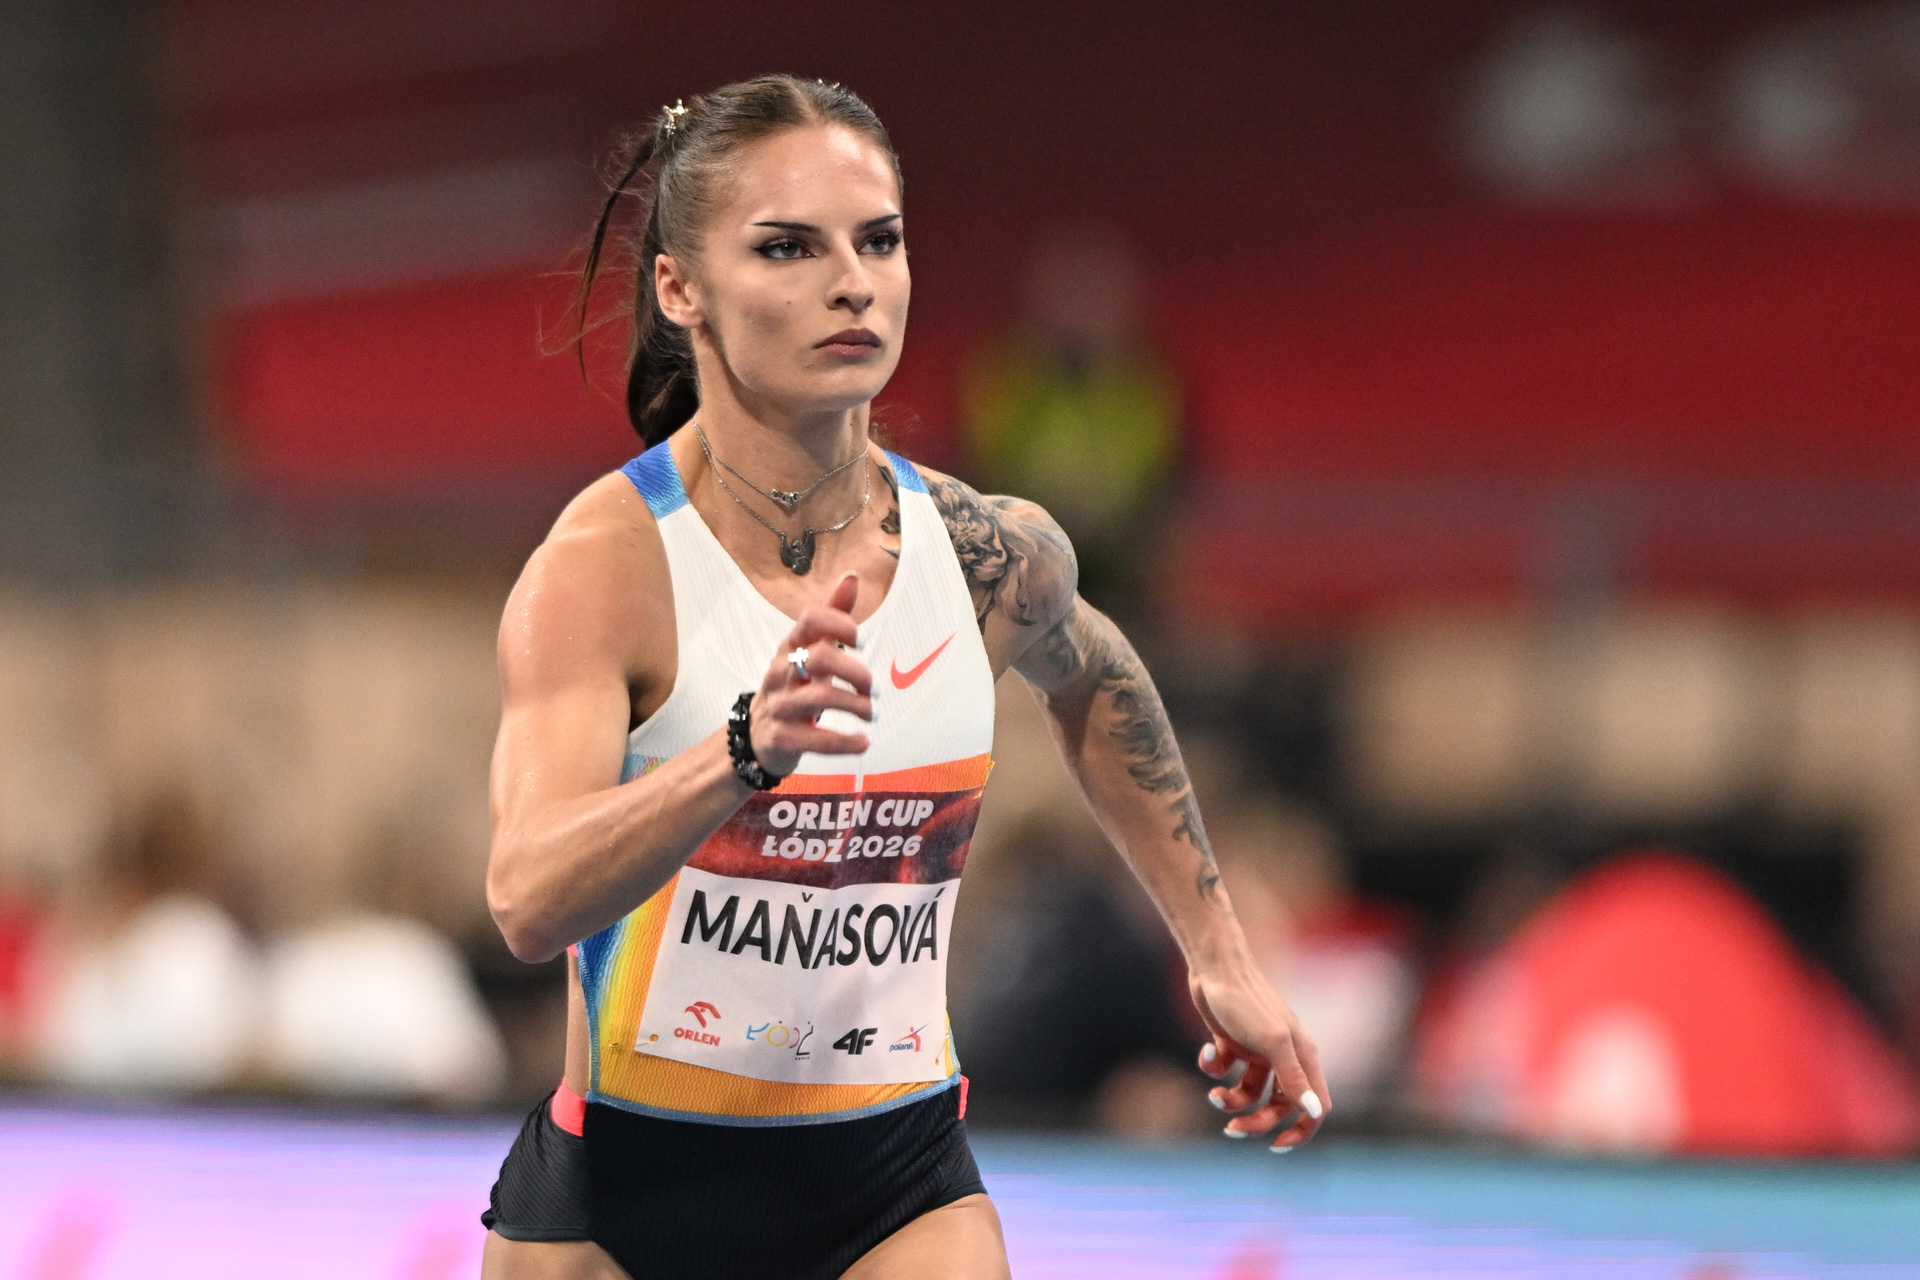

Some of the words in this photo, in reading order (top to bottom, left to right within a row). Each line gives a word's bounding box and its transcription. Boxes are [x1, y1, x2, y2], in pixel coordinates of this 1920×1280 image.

[769, 800, 873, 830] ORLEN
[876, 799, 934, 827] CUP
[762, 831, 845, 863] ŁÓDŹ
[847, 835, 924, 860] 2026
[680, 887, 946, 970] MAŇASOVÁ
[673, 1027, 721, 1047] ORLEN
[832, 1027, 878, 1055] 4F
[889, 1041, 916, 1053] polanik
